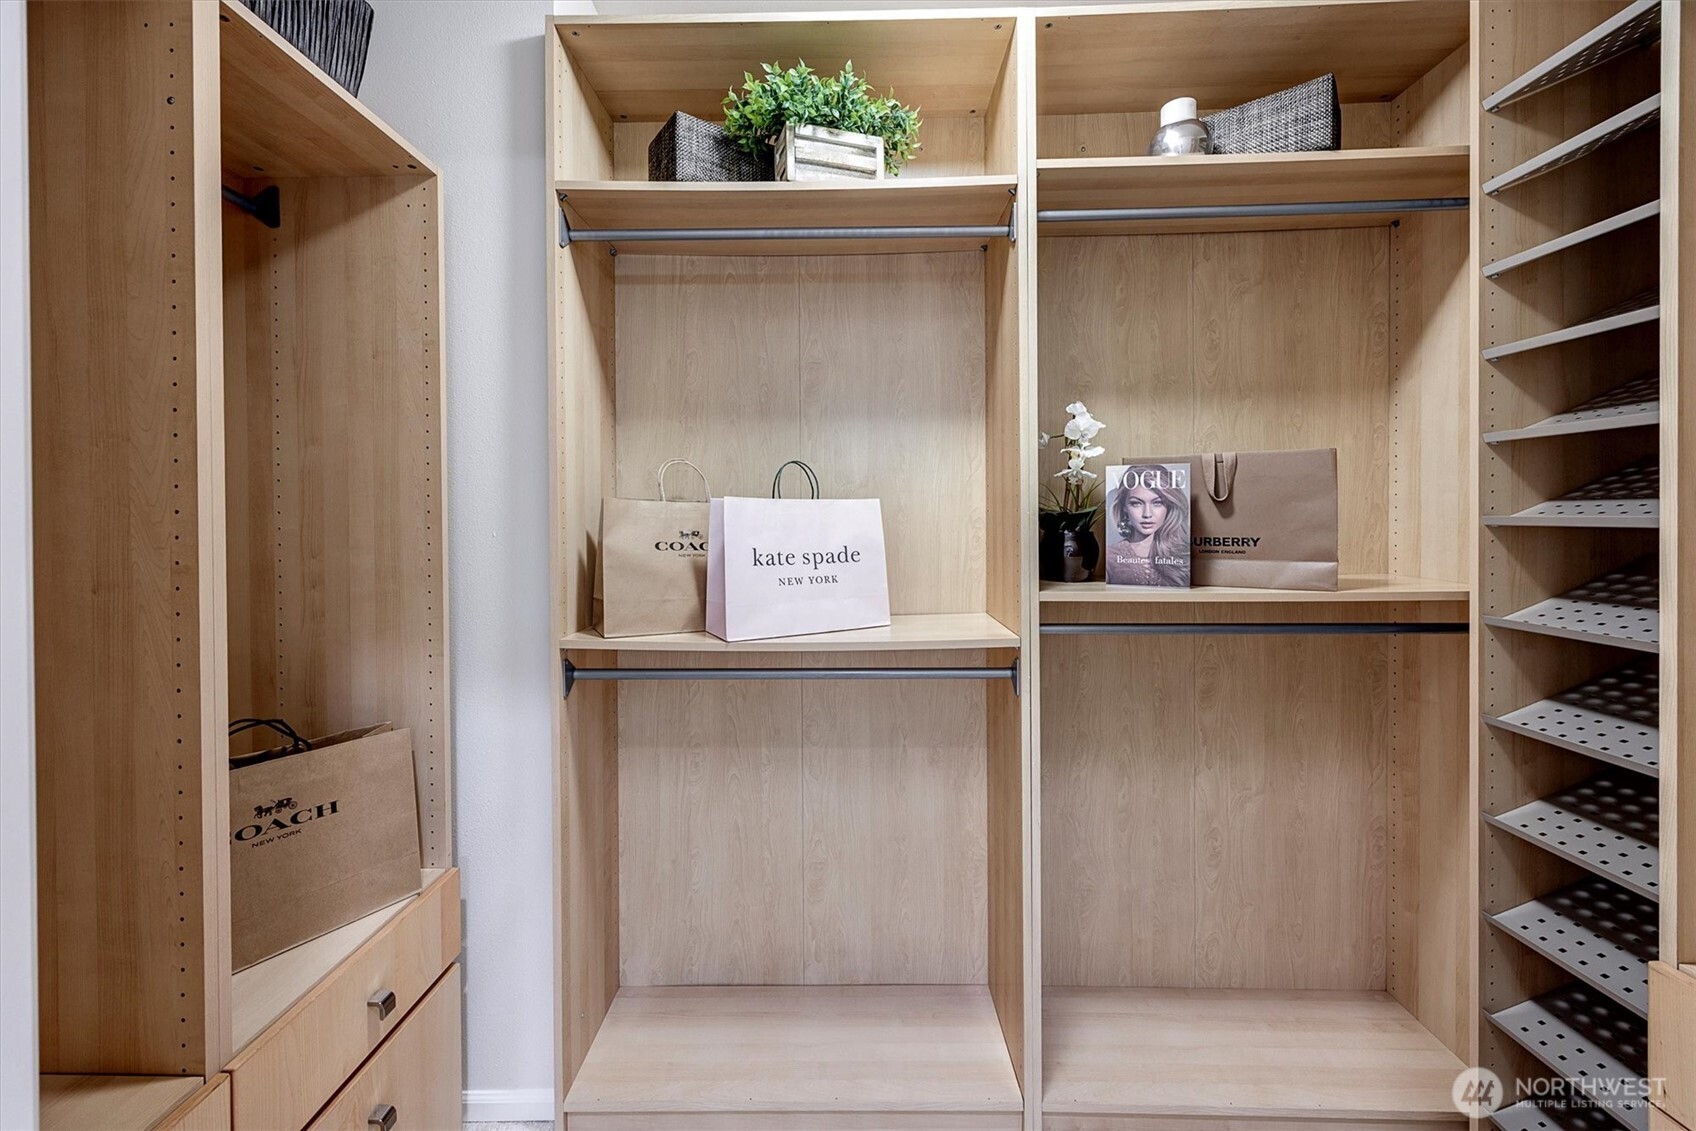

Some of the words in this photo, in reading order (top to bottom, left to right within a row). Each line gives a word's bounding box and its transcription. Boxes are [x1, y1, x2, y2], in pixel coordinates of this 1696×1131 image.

[1111, 469, 1186, 490] VOGUE
[654, 541, 708, 551] COAC
[1191, 536, 1262, 547] URBERRY
[752, 547, 796, 567] kate
[802, 545, 861, 570] spade
[778, 577, 803, 586] NEW
[808, 575, 839, 585] YORK
[229, 800, 340, 846] OACH
[251, 836, 275, 848] NEW
[276, 828, 302, 840] YORK
